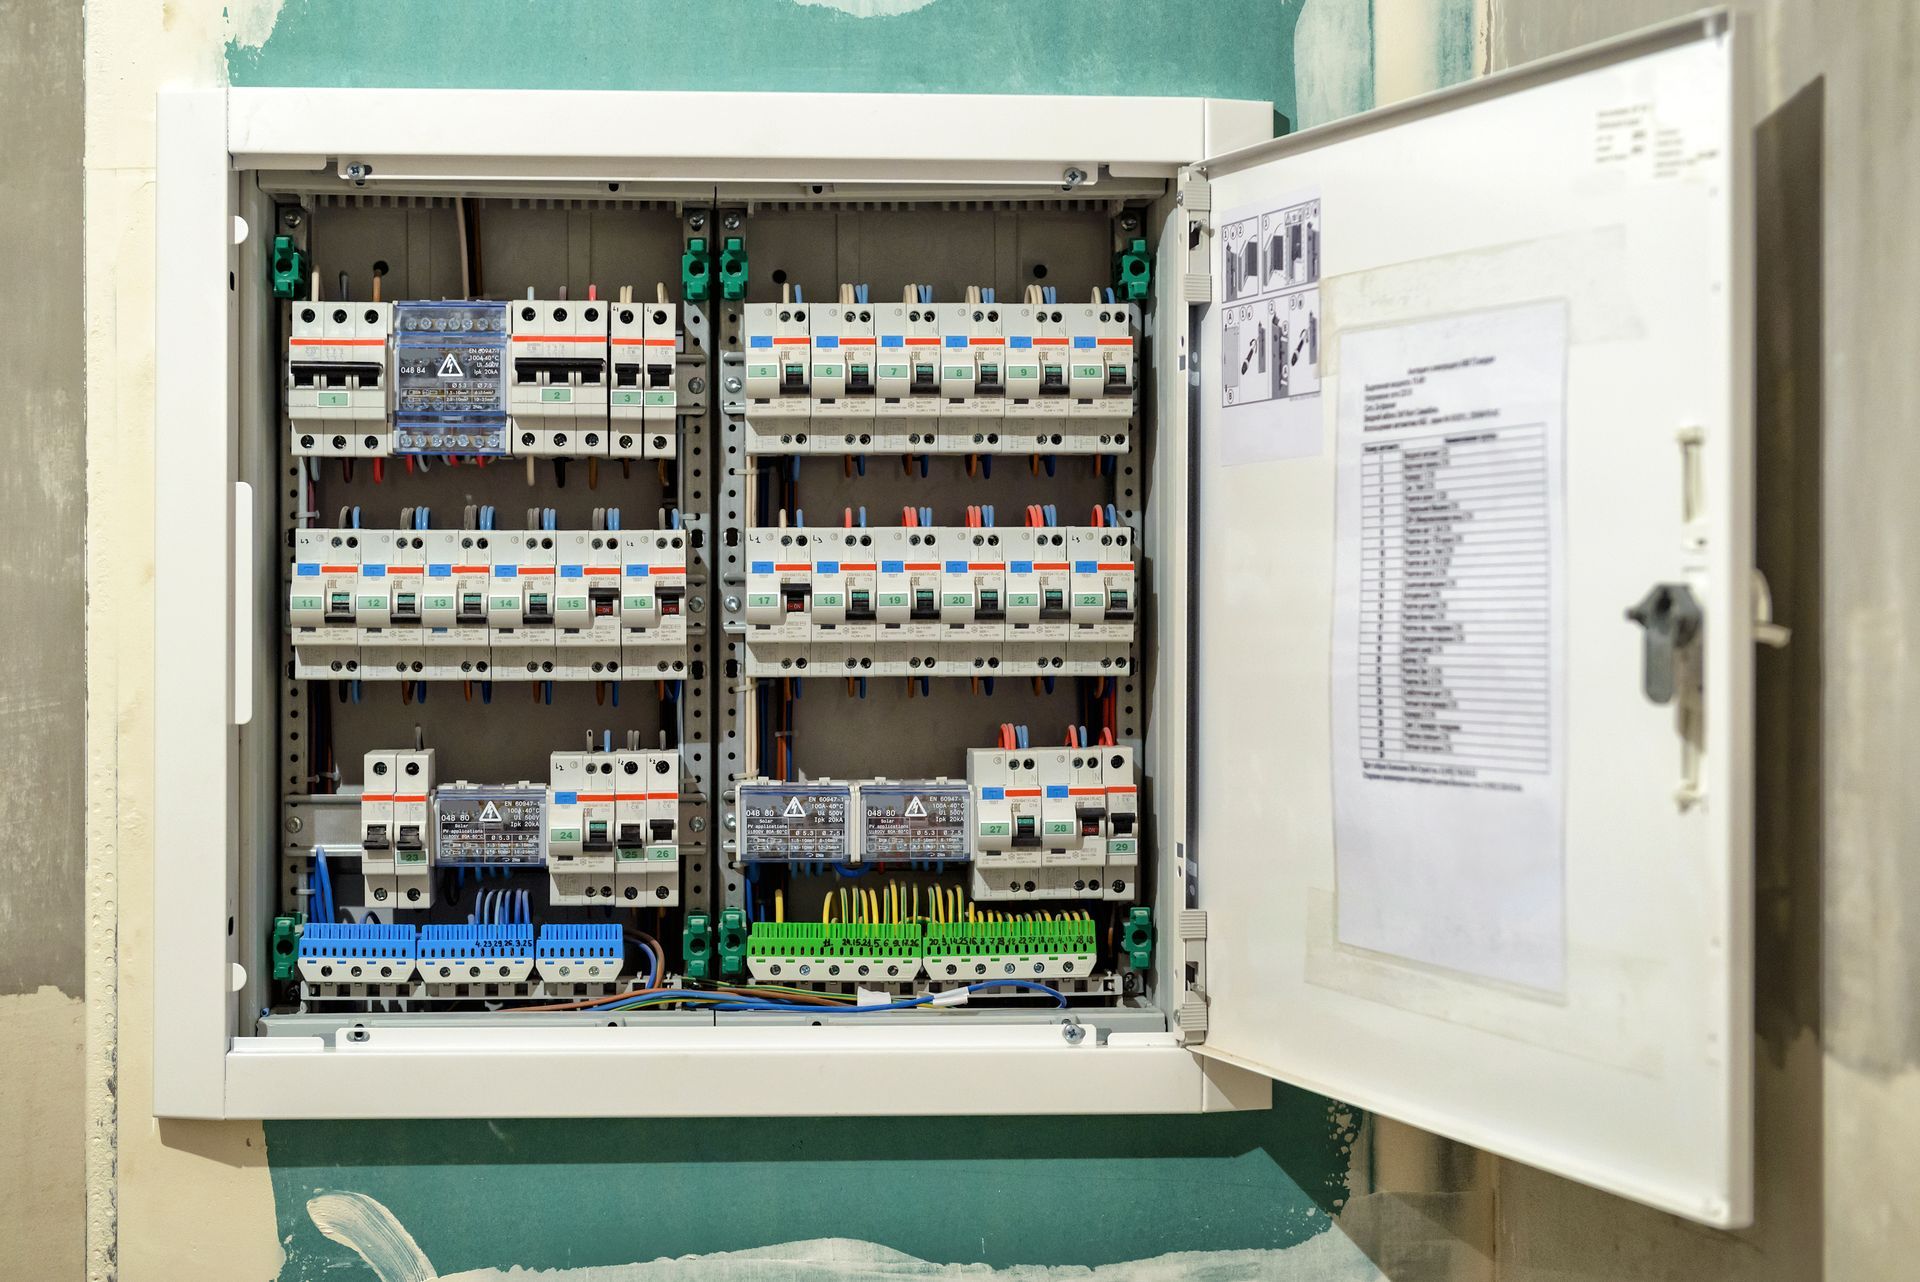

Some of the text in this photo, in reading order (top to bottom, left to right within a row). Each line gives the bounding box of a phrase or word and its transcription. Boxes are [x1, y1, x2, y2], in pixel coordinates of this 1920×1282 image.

[956, 369, 962, 377] 8
[1021, 368, 1027, 376] 9
[1083, 368, 1095, 376] 10
[332, 396, 336, 404] 1
[624, 394, 631, 402] 3
[302, 599, 313, 607] 11
[368, 599, 380, 607] 12
[433, 599, 446, 607] 13
[656, 850, 669, 858] 26
